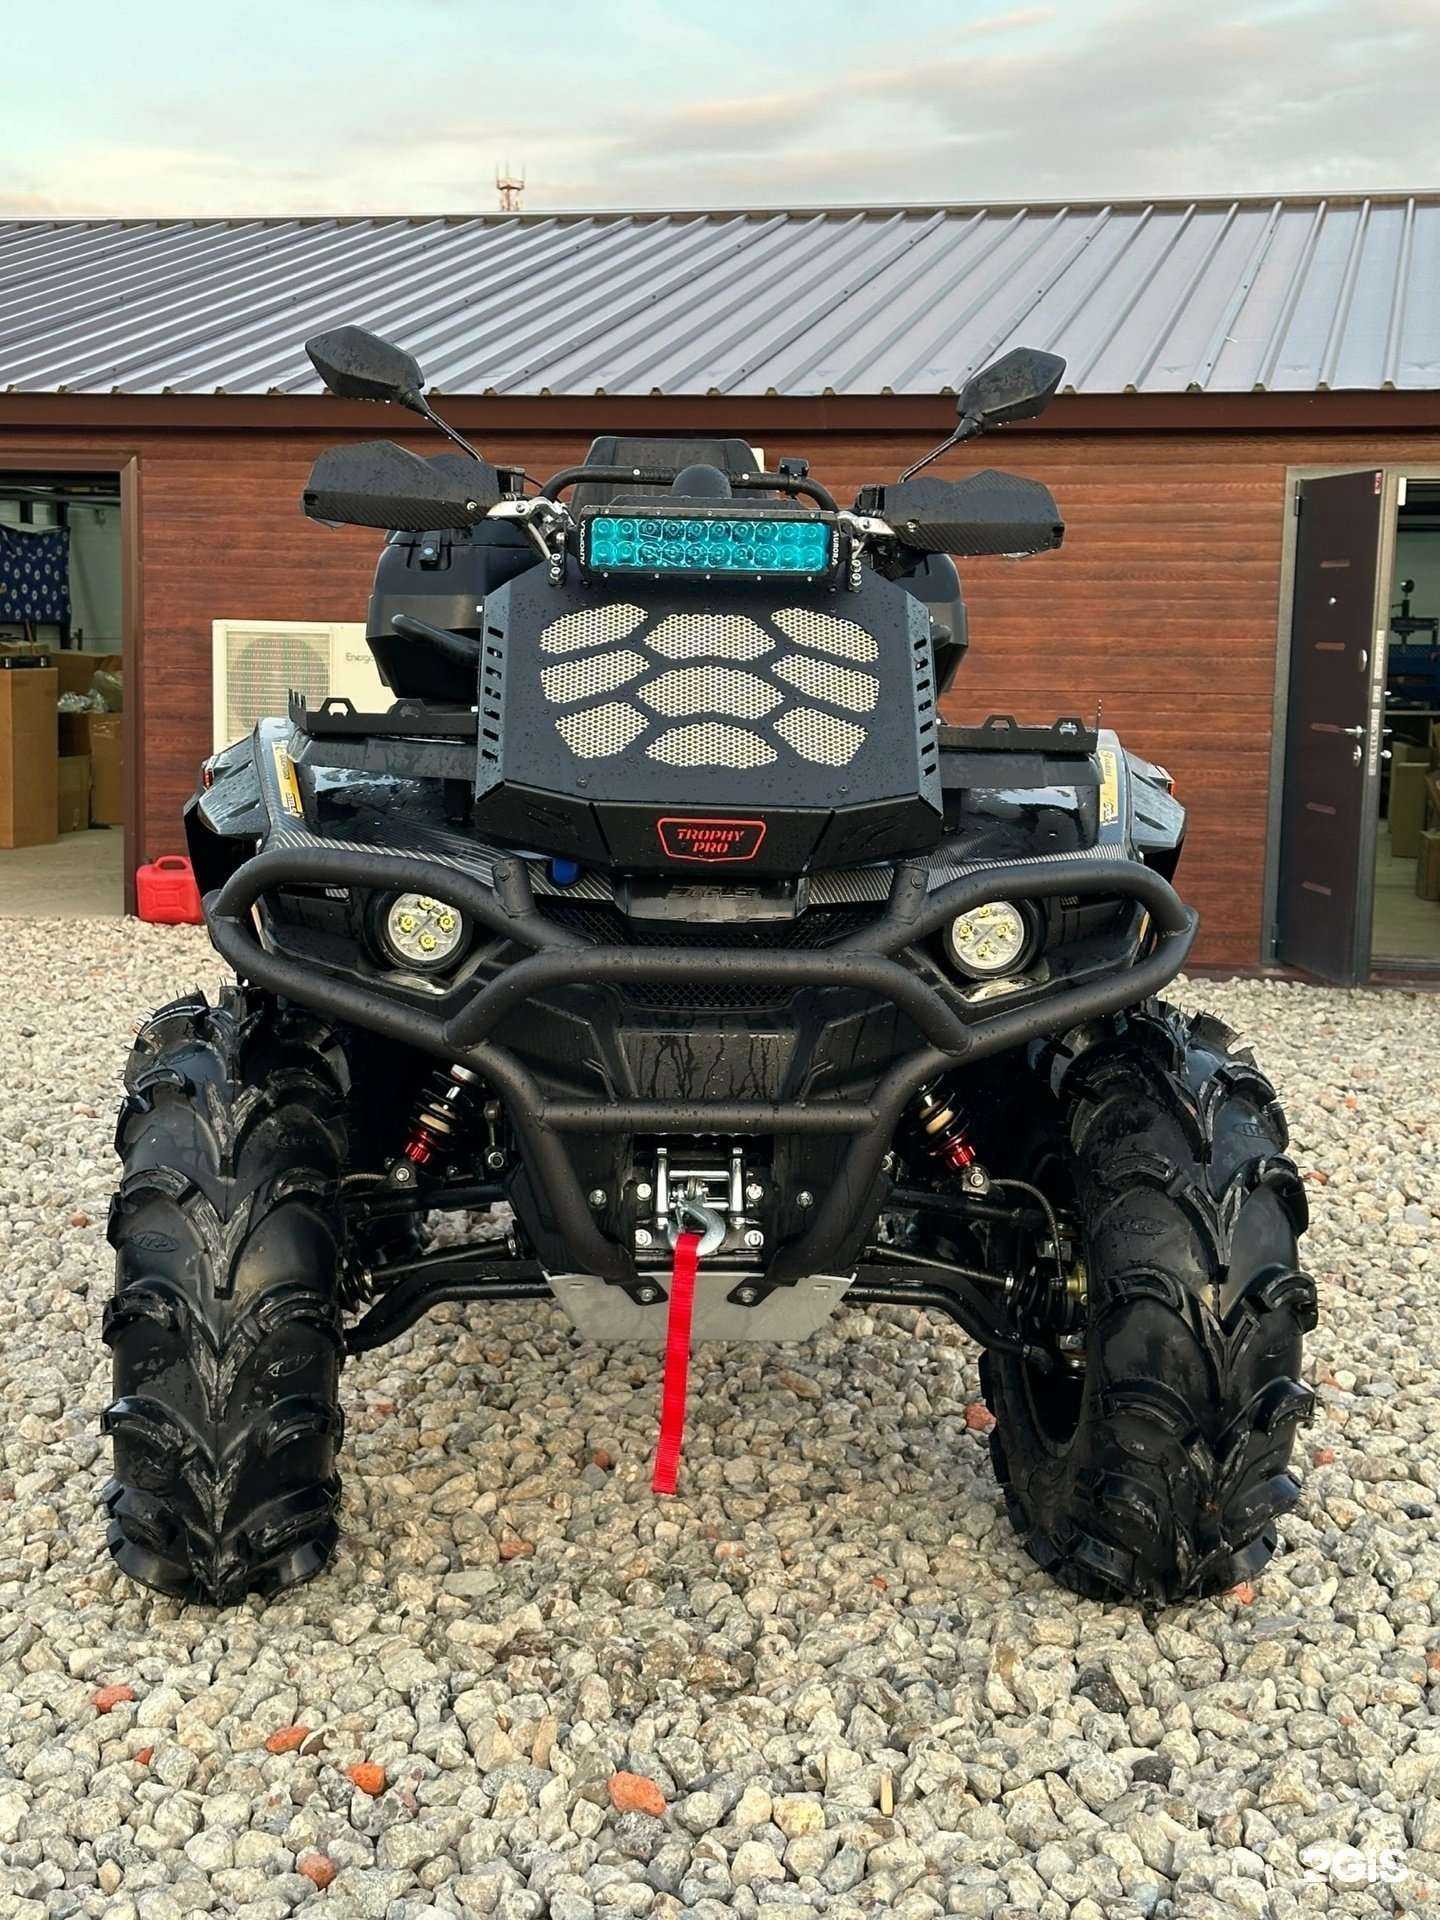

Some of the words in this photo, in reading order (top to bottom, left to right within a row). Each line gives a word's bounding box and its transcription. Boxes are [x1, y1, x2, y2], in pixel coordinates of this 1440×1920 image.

[832, 530, 840, 567] AURORA
[676, 828, 745, 841] TROPHY
[692, 841, 729, 853] PRO
